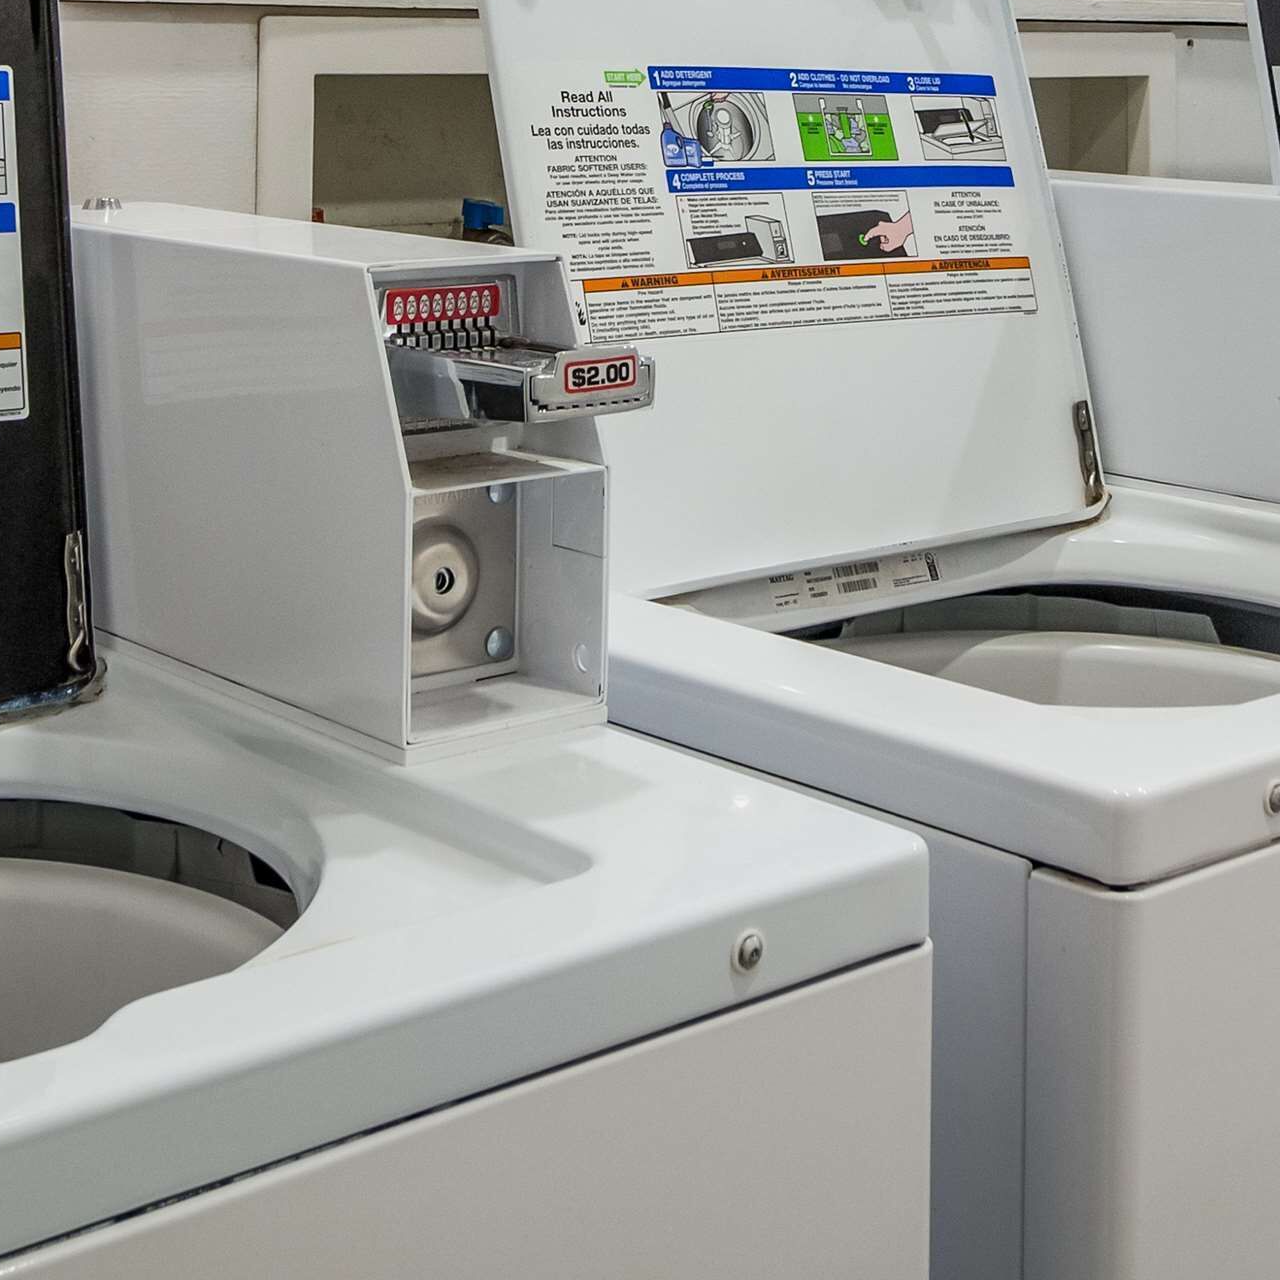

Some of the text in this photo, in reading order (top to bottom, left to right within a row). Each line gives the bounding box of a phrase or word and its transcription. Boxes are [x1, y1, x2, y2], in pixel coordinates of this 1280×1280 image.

[653, 71, 712, 86] 1 ADD DETERGENT
[790, 72, 798, 87] 2
[907, 76, 915, 90] 3
[561, 91, 613, 103] Read All
[551, 106, 627, 118] Instructions
[531, 124, 651, 137] Lea con cuidado todas
[547, 137, 640, 150] las instrucciones.
[574, 154, 617, 163] ATTENTION
[547, 163, 648, 173] FABRIC SOFTENER USERS:
[672, 172, 745, 190] 4 COMPLETE PROCESS
[807, 171, 815, 186] 5
[834, 170, 851, 178] START
[546, 188, 587, 198] ATENCIÓN
[596, 187, 636, 196] AQUÉLLOS
[547, 200, 568, 208] USAN
[571, 198, 618, 207] SUAVIZANTE
[633, 196, 658, 204] TELAS:
[939, 260, 990, 270] ADVERTENCIA
[770, 266, 840, 279] AVERTISSEMENT
[631, 276, 678, 287] WARNING
[572, 362, 630, 387] $2.00
